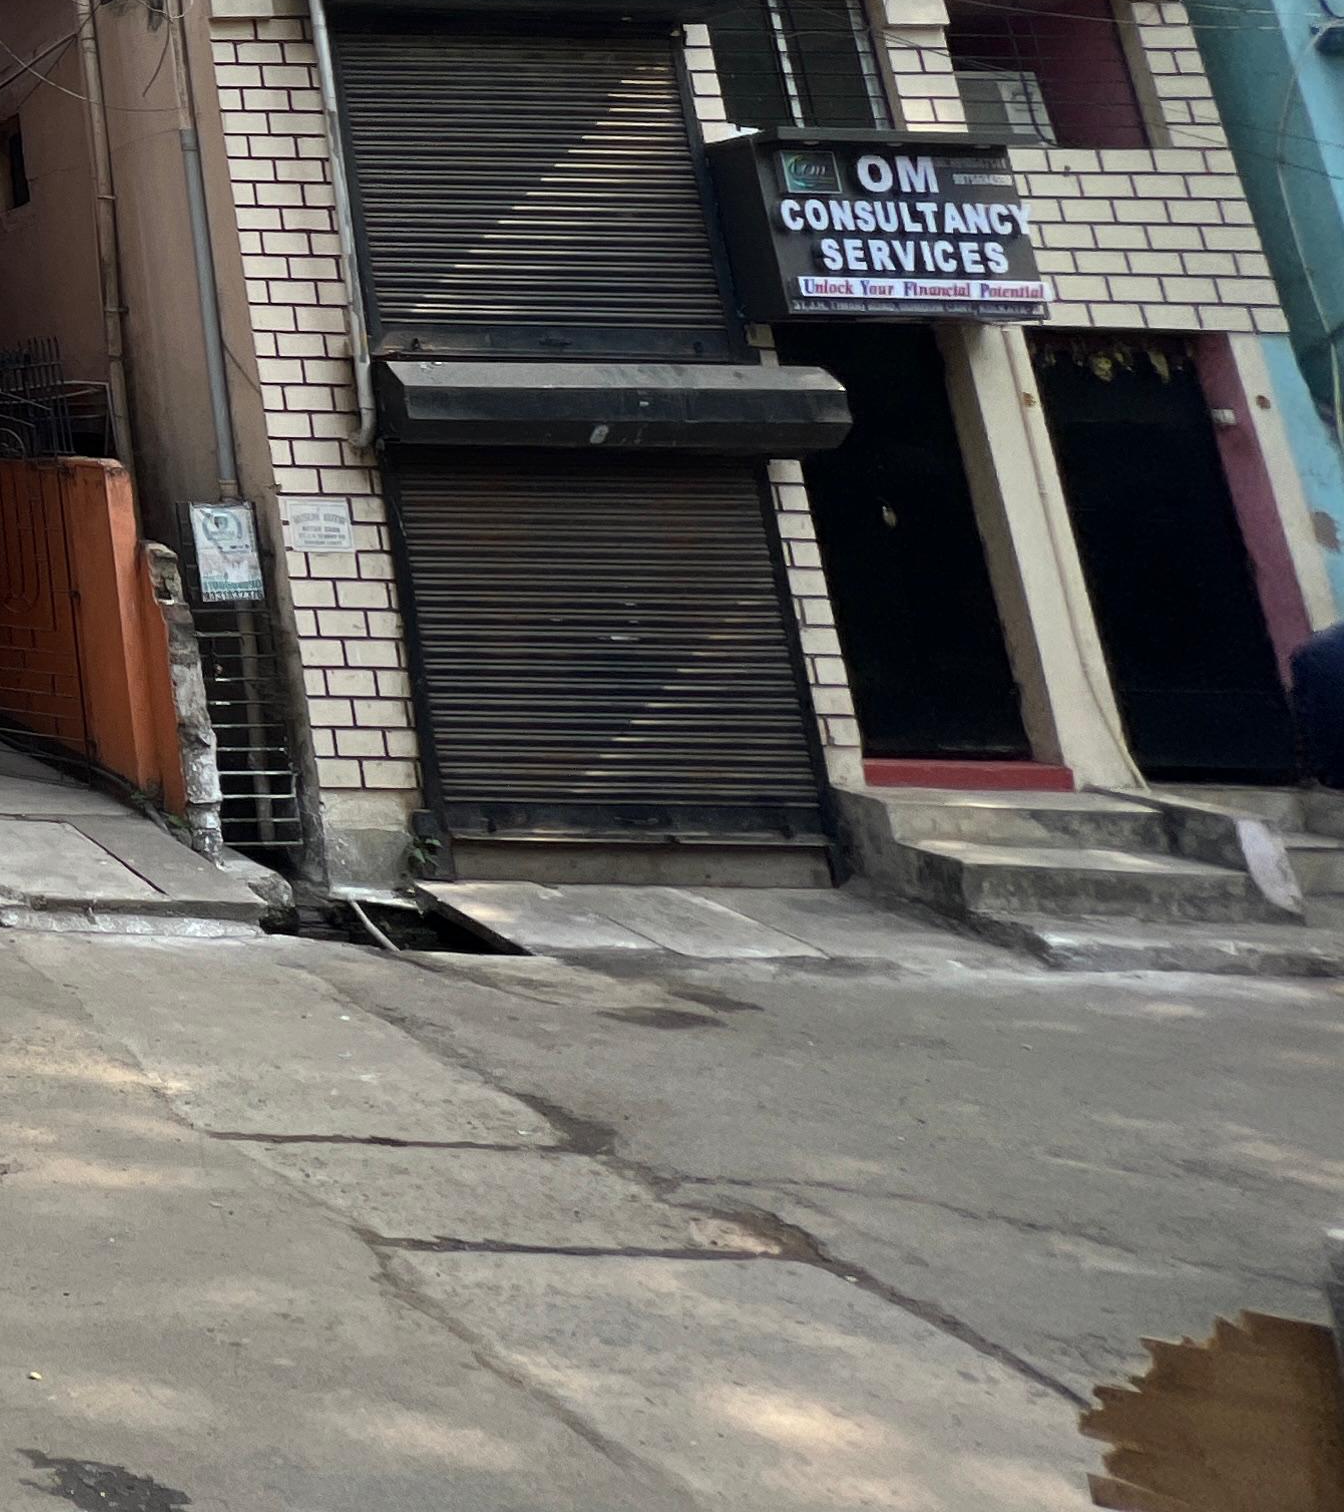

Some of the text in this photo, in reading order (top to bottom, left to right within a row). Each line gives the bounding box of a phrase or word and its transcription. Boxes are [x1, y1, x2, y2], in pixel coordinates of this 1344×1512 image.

[857, 154, 939, 193] OM
[780, 199, 1032, 235] CONSULTANCY
[821, 238, 1009, 274] SERVICES
[804, 279, 1044, 299] Unlock Your Financial Potential
